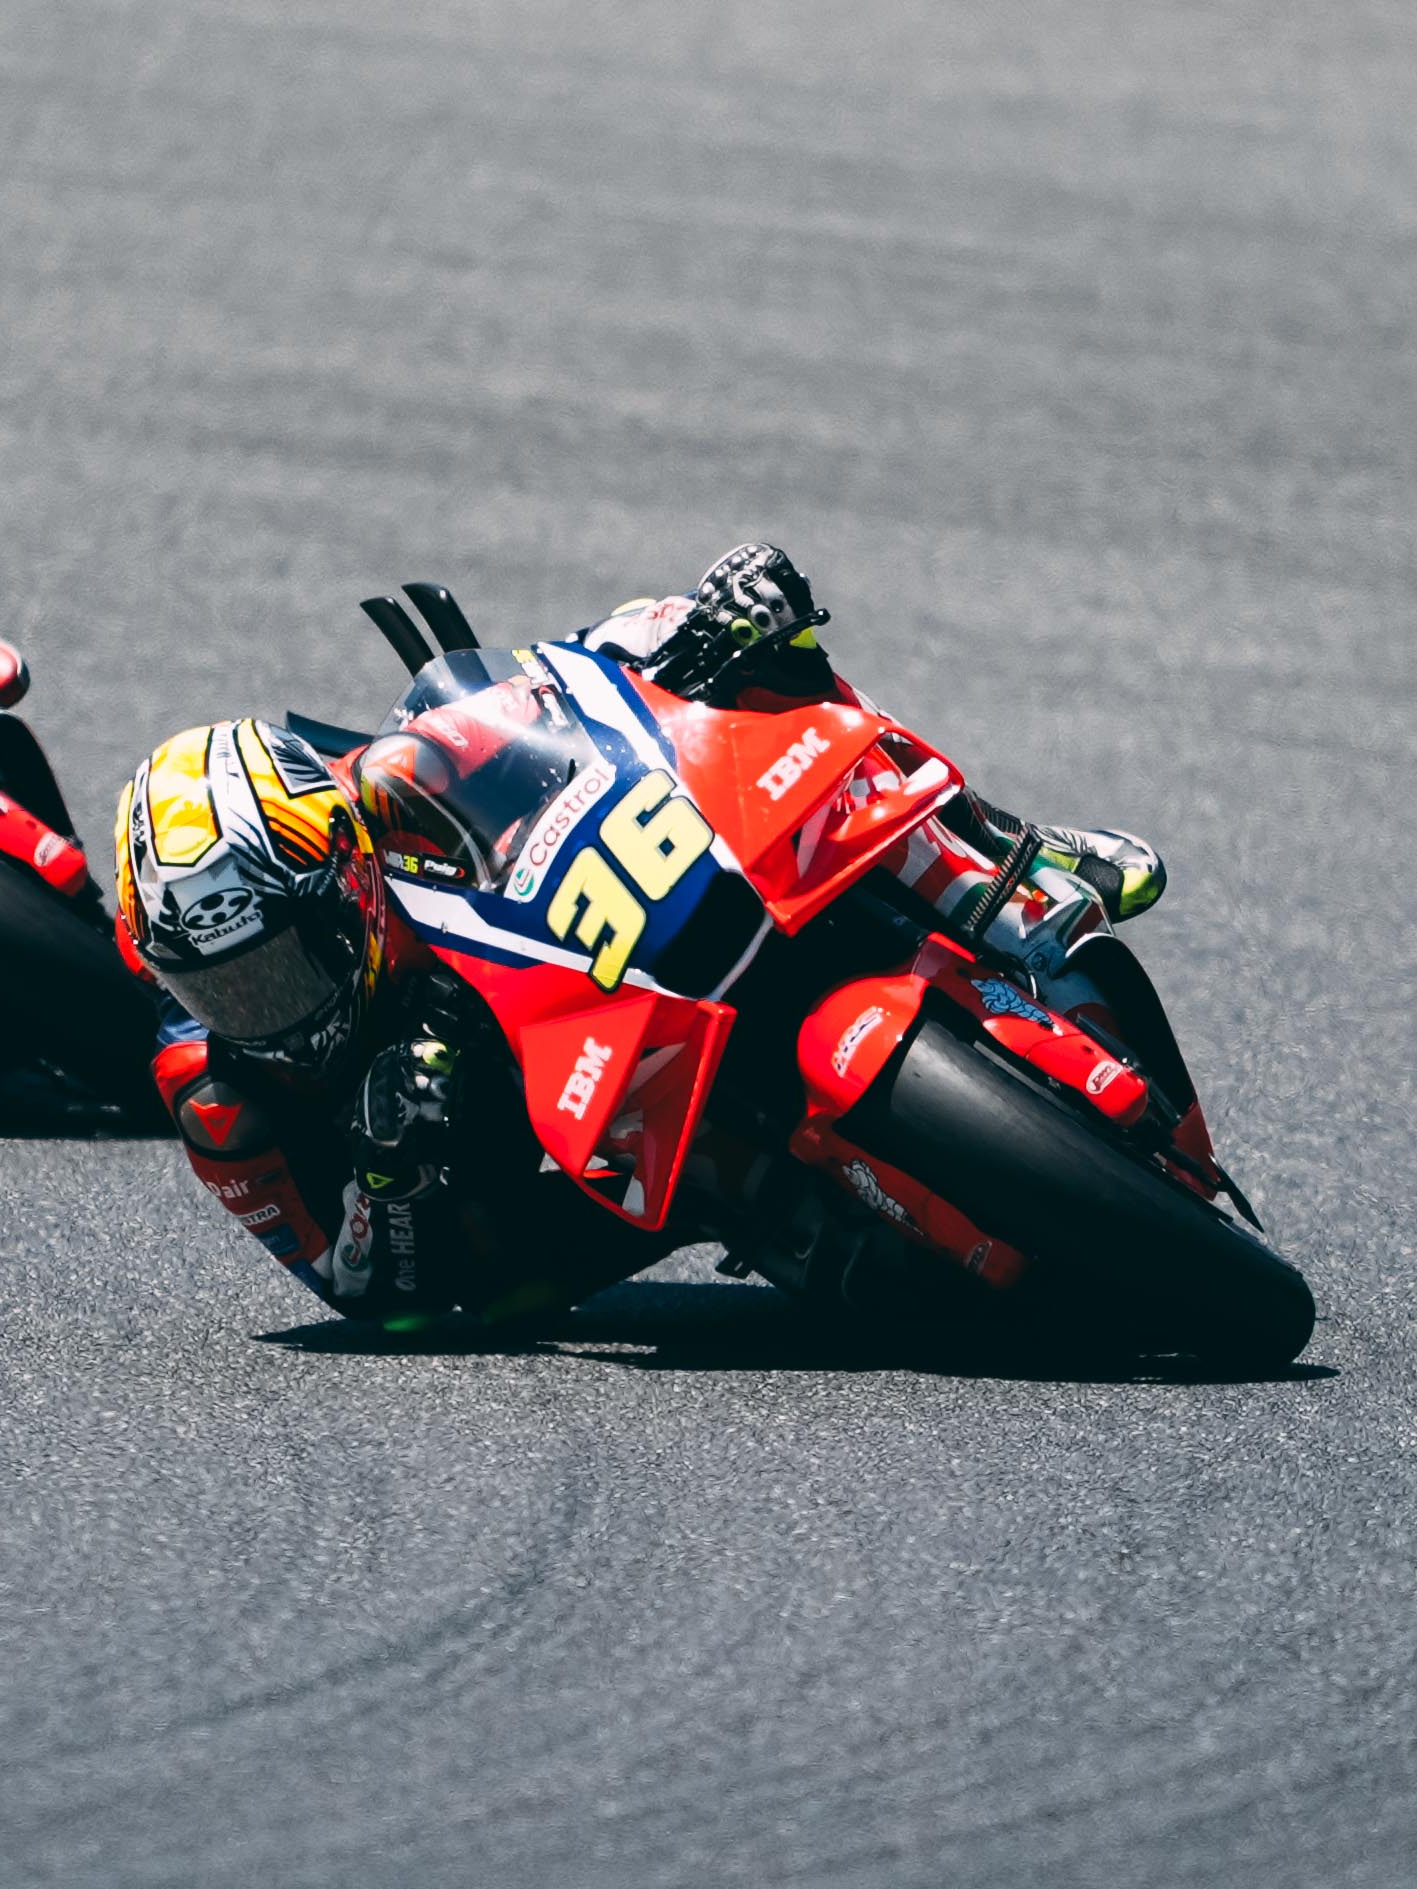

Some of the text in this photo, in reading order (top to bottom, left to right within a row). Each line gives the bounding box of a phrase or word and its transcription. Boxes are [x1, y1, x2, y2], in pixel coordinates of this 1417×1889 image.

[756, 727, 830, 801] IBM
[529, 768, 609, 866] Castrol
[547, 769, 714, 992] 36
[191, 911, 261, 945] Kabuto
[557, 1037, 612, 1120] IBM
